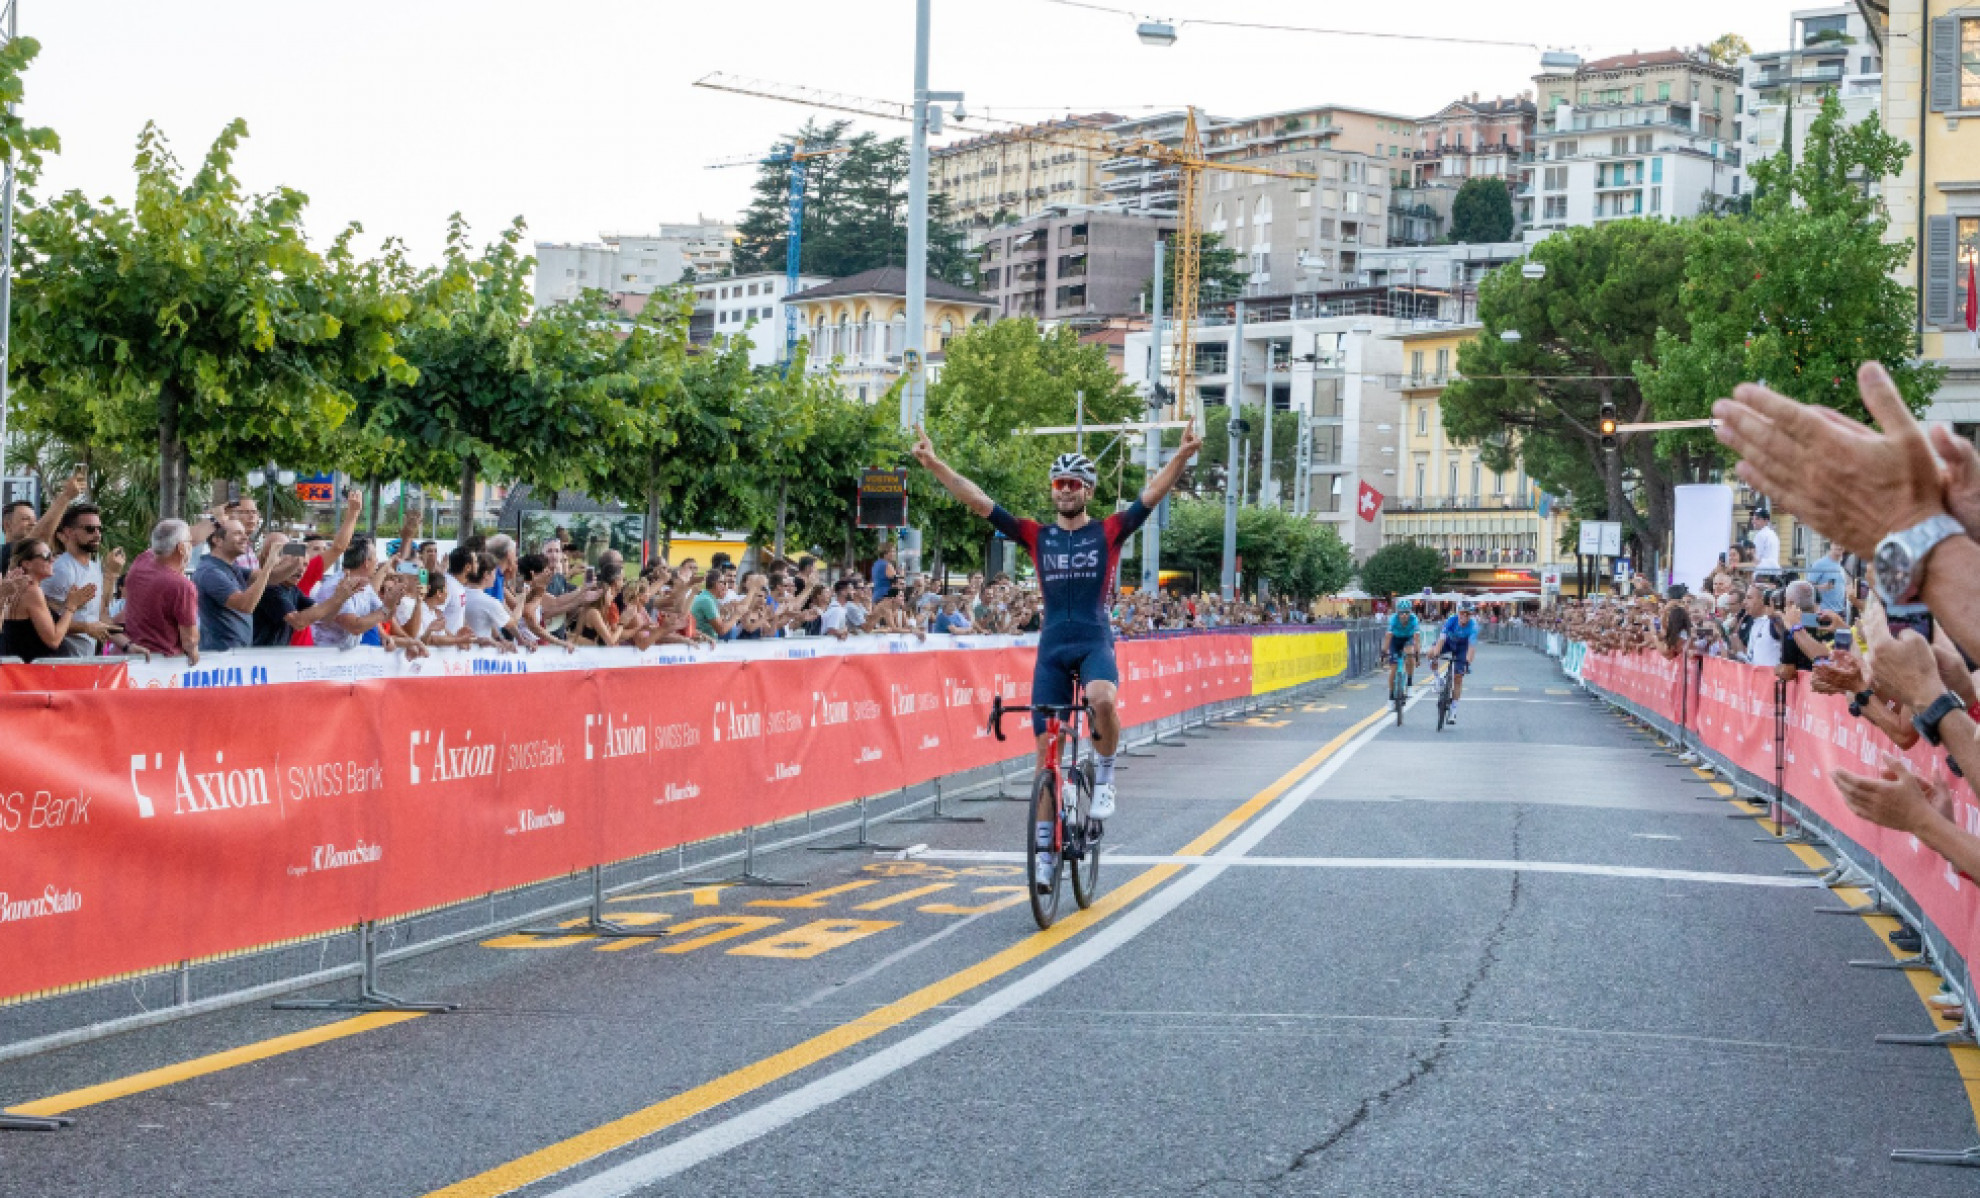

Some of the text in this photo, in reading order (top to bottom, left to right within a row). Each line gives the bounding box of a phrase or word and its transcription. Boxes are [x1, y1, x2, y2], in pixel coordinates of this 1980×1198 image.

[1043, 550, 1099, 570] INEOS
[431, 728, 565, 782] Axion SWISS Bank
[602, 712, 646, 759] Axion
[174, 750, 383, 814] Axion SWISS Bank
[28, 788, 92, 829] Bank
[478, 912, 904, 959] BUS
